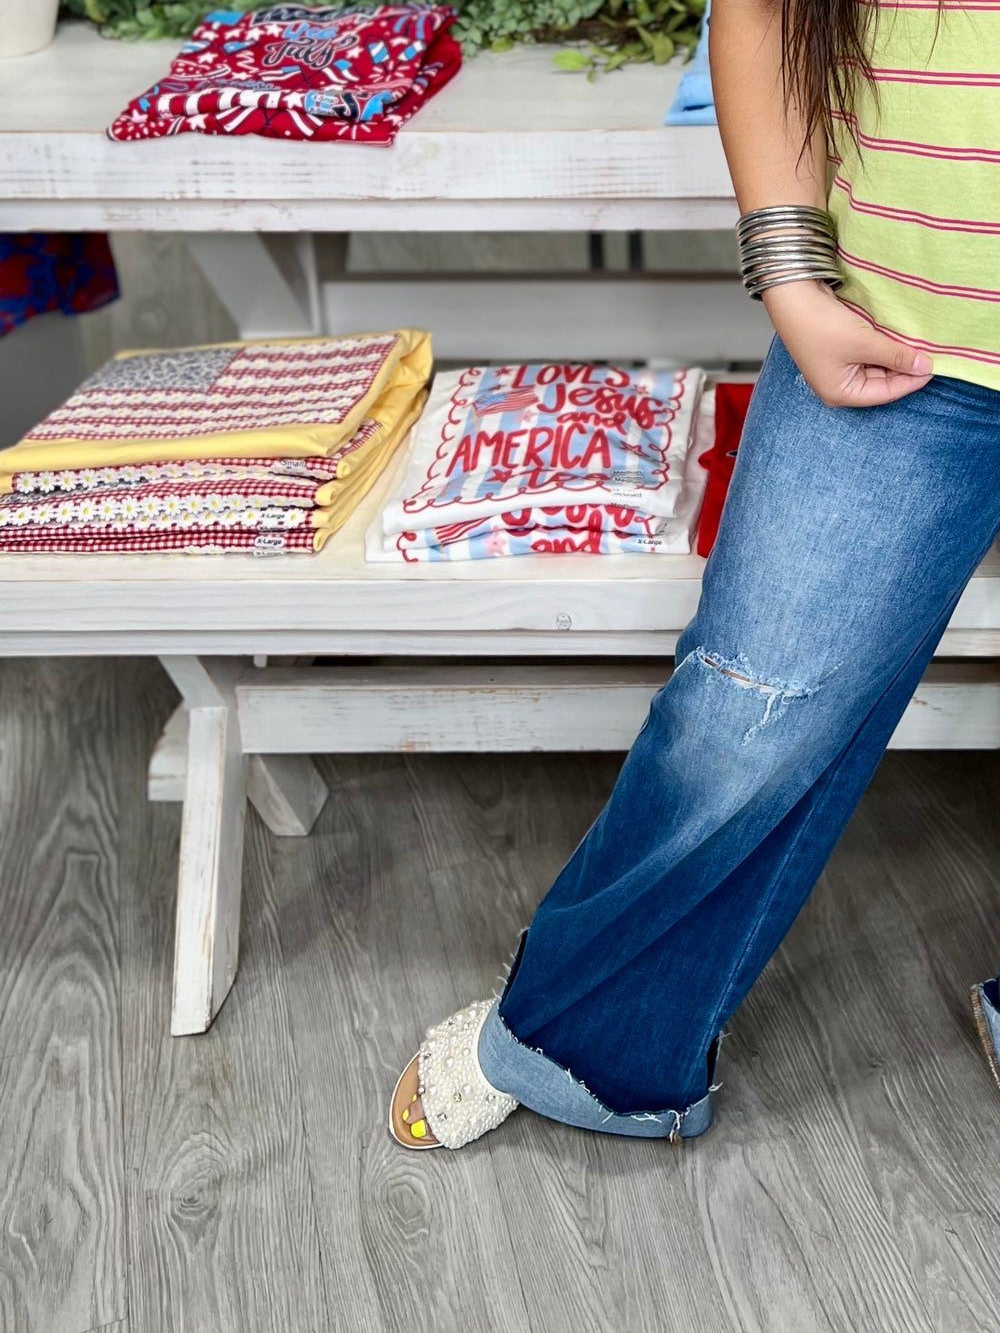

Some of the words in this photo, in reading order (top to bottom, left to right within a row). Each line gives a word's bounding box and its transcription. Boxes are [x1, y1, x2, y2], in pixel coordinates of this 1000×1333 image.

[511, 364, 631, 389] LOVES
[536, 383, 667, 430] Jesus
[445, 423, 612, 478] AMERICA
[256, 538, 283, 546] X-Large
[637, 539, 663, 547] X-Large
